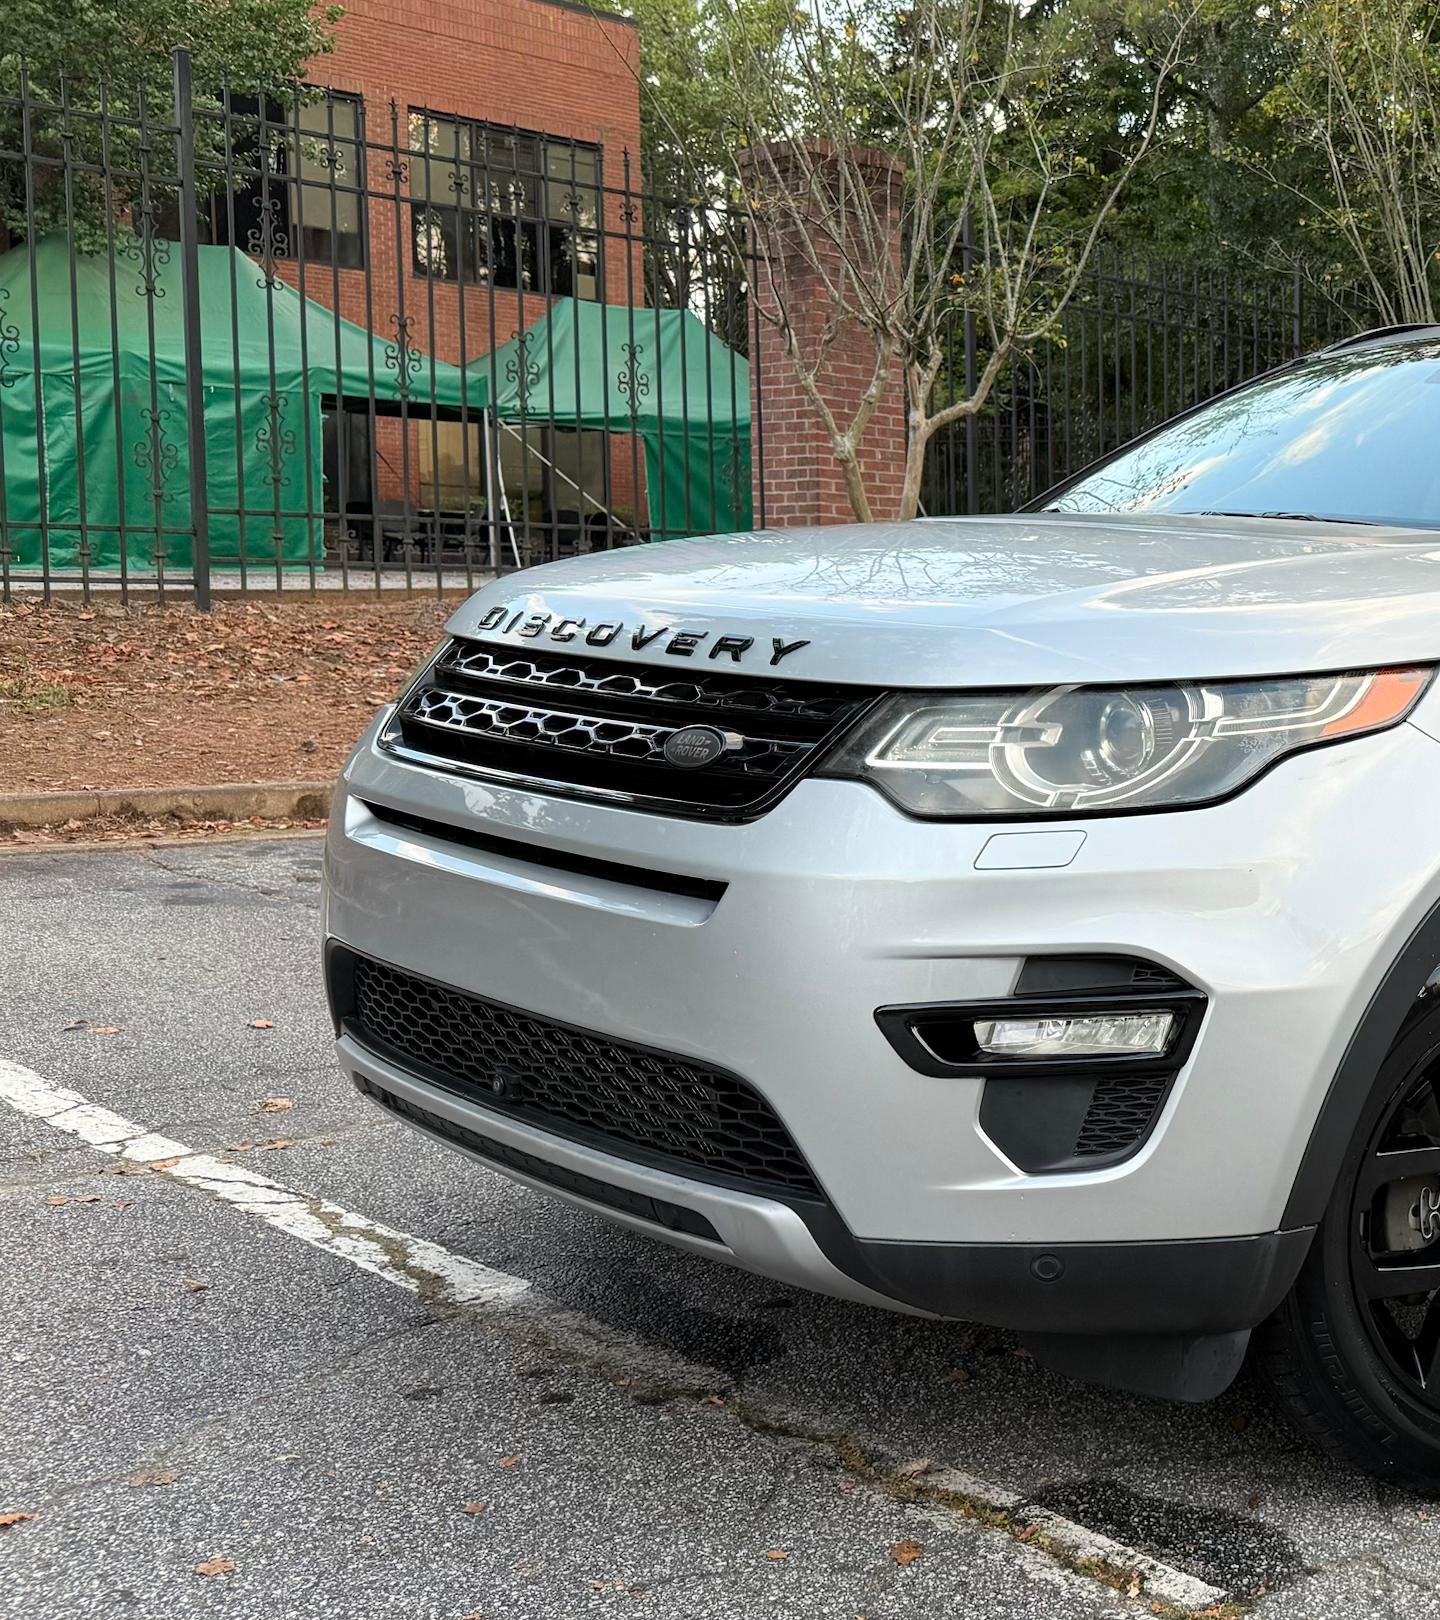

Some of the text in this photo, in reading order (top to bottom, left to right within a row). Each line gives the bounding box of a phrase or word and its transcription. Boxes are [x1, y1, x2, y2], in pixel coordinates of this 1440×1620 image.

[477, 605, 812, 666] DISCOVERY
[676, 734, 706, 747] LAND
[674, 745, 710, 760] ROVER
